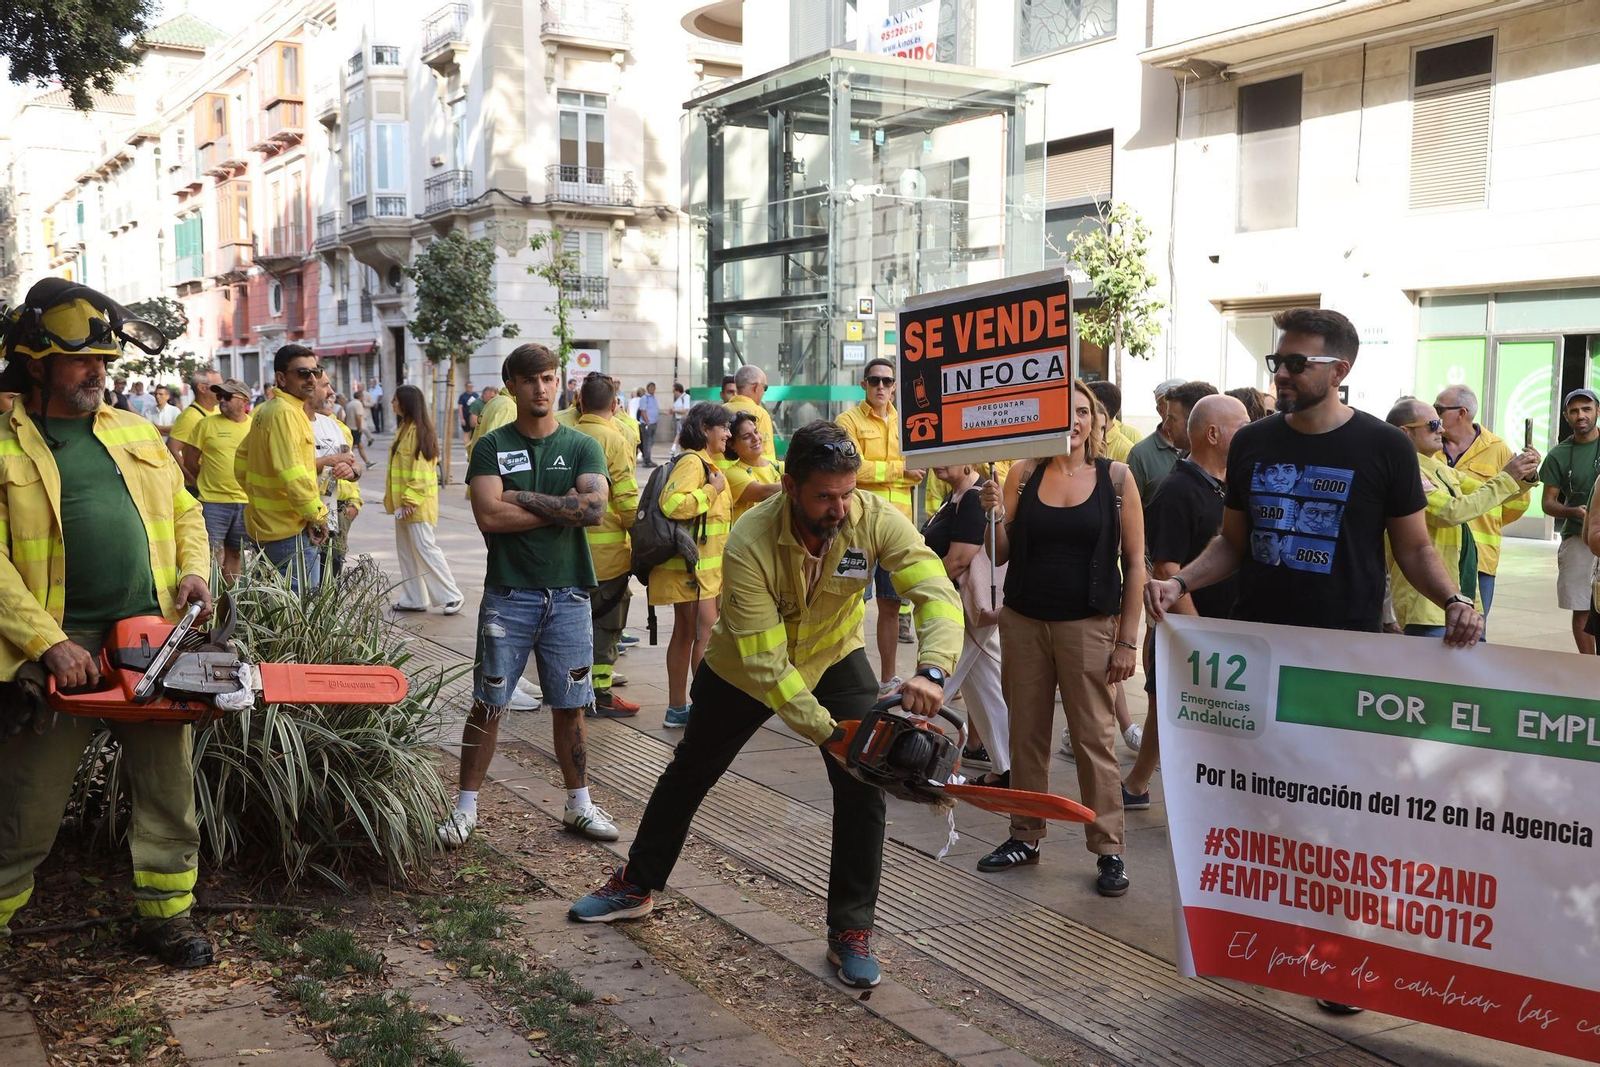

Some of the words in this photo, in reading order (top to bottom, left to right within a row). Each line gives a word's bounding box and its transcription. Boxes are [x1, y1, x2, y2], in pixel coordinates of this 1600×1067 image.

[904, 317, 944, 362] SE
[952, 293, 1068, 354] VENDE
[977, 400, 1025, 411] PREGUNTAR
[963, 419, 999, 430] JUANMA
[1000, 414, 1039, 424] MORENO
[1312, 478, 1348, 494] GOOD
[1260, 506, 1285, 520] BAD
[1295, 548, 1330, 565] BOSS
[1187, 650, 1247, 692] 112
[337, 680, 376, 689] Husqvarna
[1181, 691, 1251, 712] Emergencias
[1356, 689, 1427, 726] POR
[1450, 701, 1492, 734] EL
[1177, 705, 1256, 731] Andalucía
[1196, 763, 1226, 787] Por
[1230, 769, 1247, 792] la
[1251, 772, 1362, 811] integración
[1368, 791, 1400, 817] del
[1406, 796, 1437, 823] 112
[1442, 804, 1469, 828] en
[1475, 806, 1495, 832] la
[1501, 811, 1594, 848] Agencia
[1203, 826, 1498, 911] #SINEXCUSAS112AND
[1199, 862, 1494, 951] #EMPLEOPUBLICO112
[1227, 930, 1258, 960] El
[1268, 944, 1337, 977] poder
[1350, 956, 1380, 989] de
[1393, 975, 1501, 1011] cambiar
[1517, 993, 1560, 1030] las
